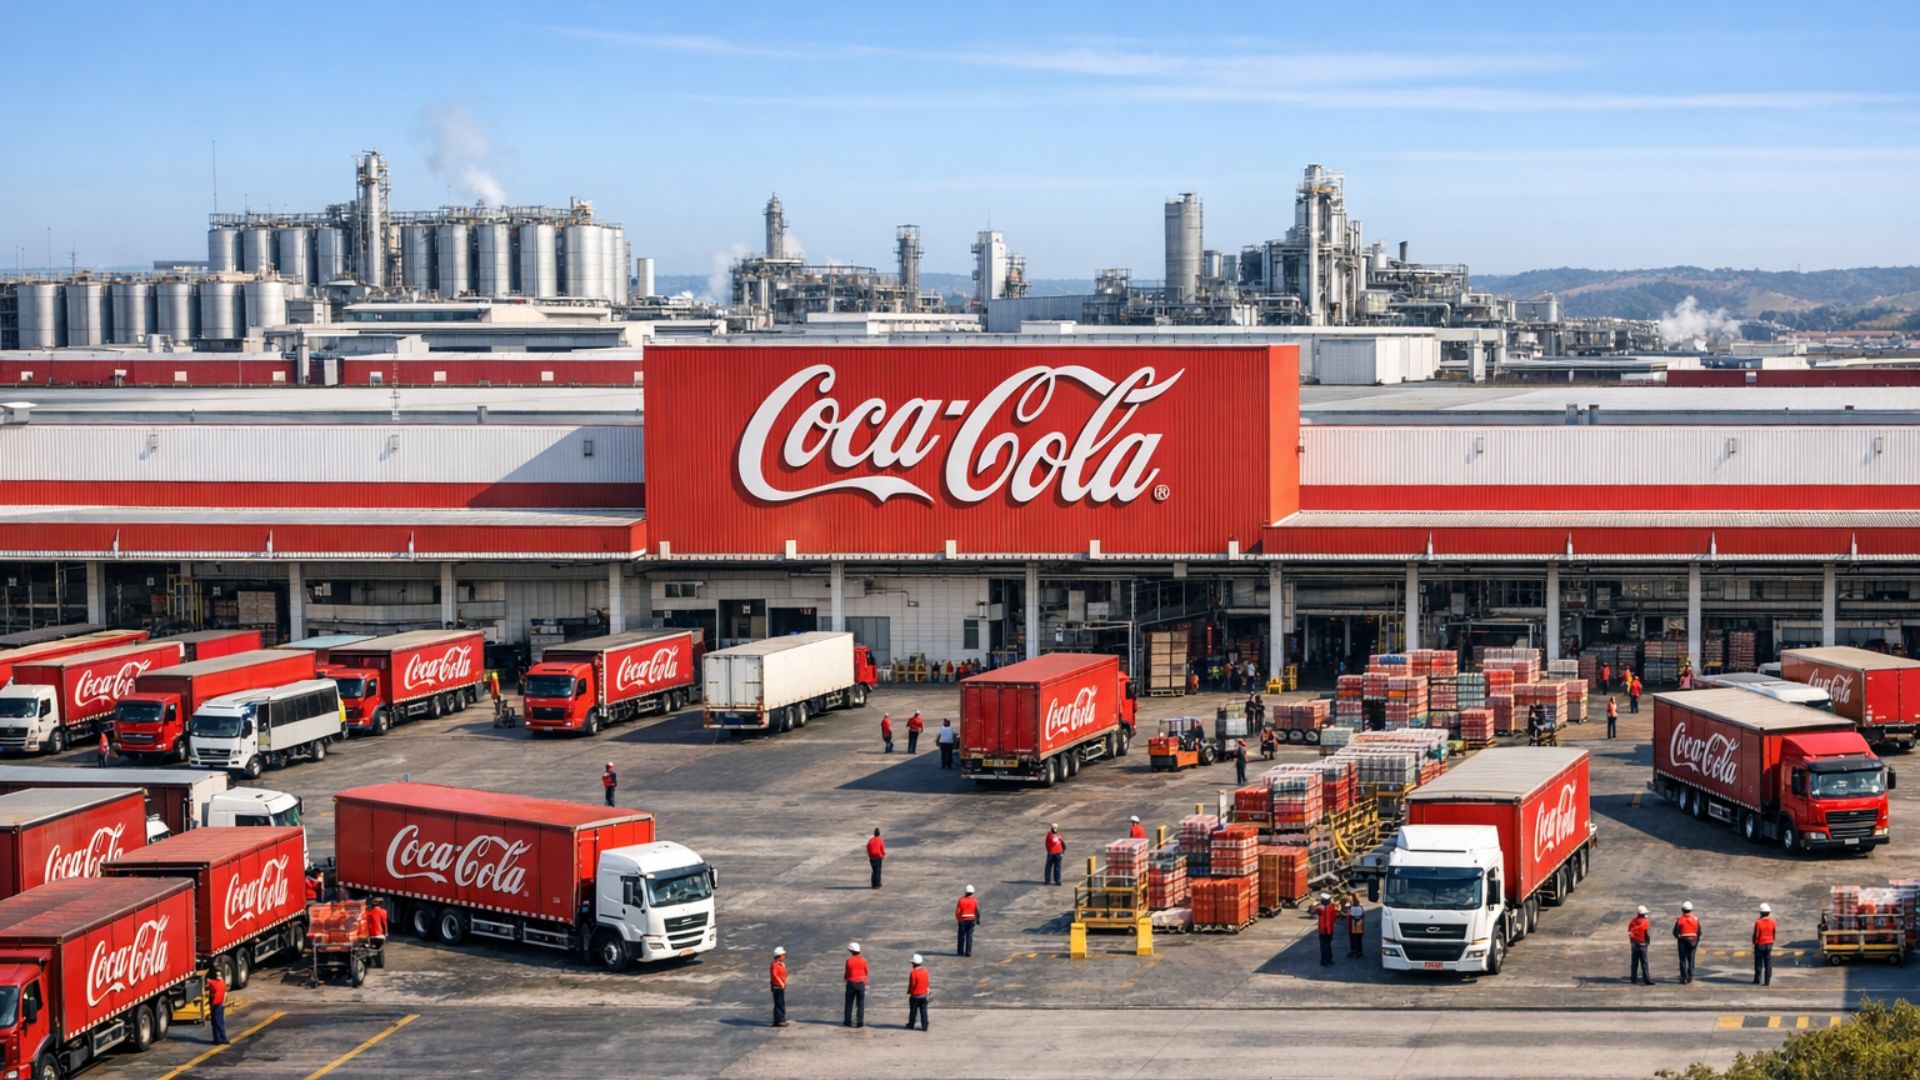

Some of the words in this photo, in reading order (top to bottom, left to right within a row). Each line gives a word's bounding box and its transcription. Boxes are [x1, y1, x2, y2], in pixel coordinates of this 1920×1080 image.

[404, 644, 472, 690] Coca-Cola
[616, 645, 679, 692] Coca-Cola
[1670, 721, 1741, 785] Coca-Cola
[224, 854, 290, 931] Coca-Cola
[86, 914, 171, 1008] Coca-Cola
